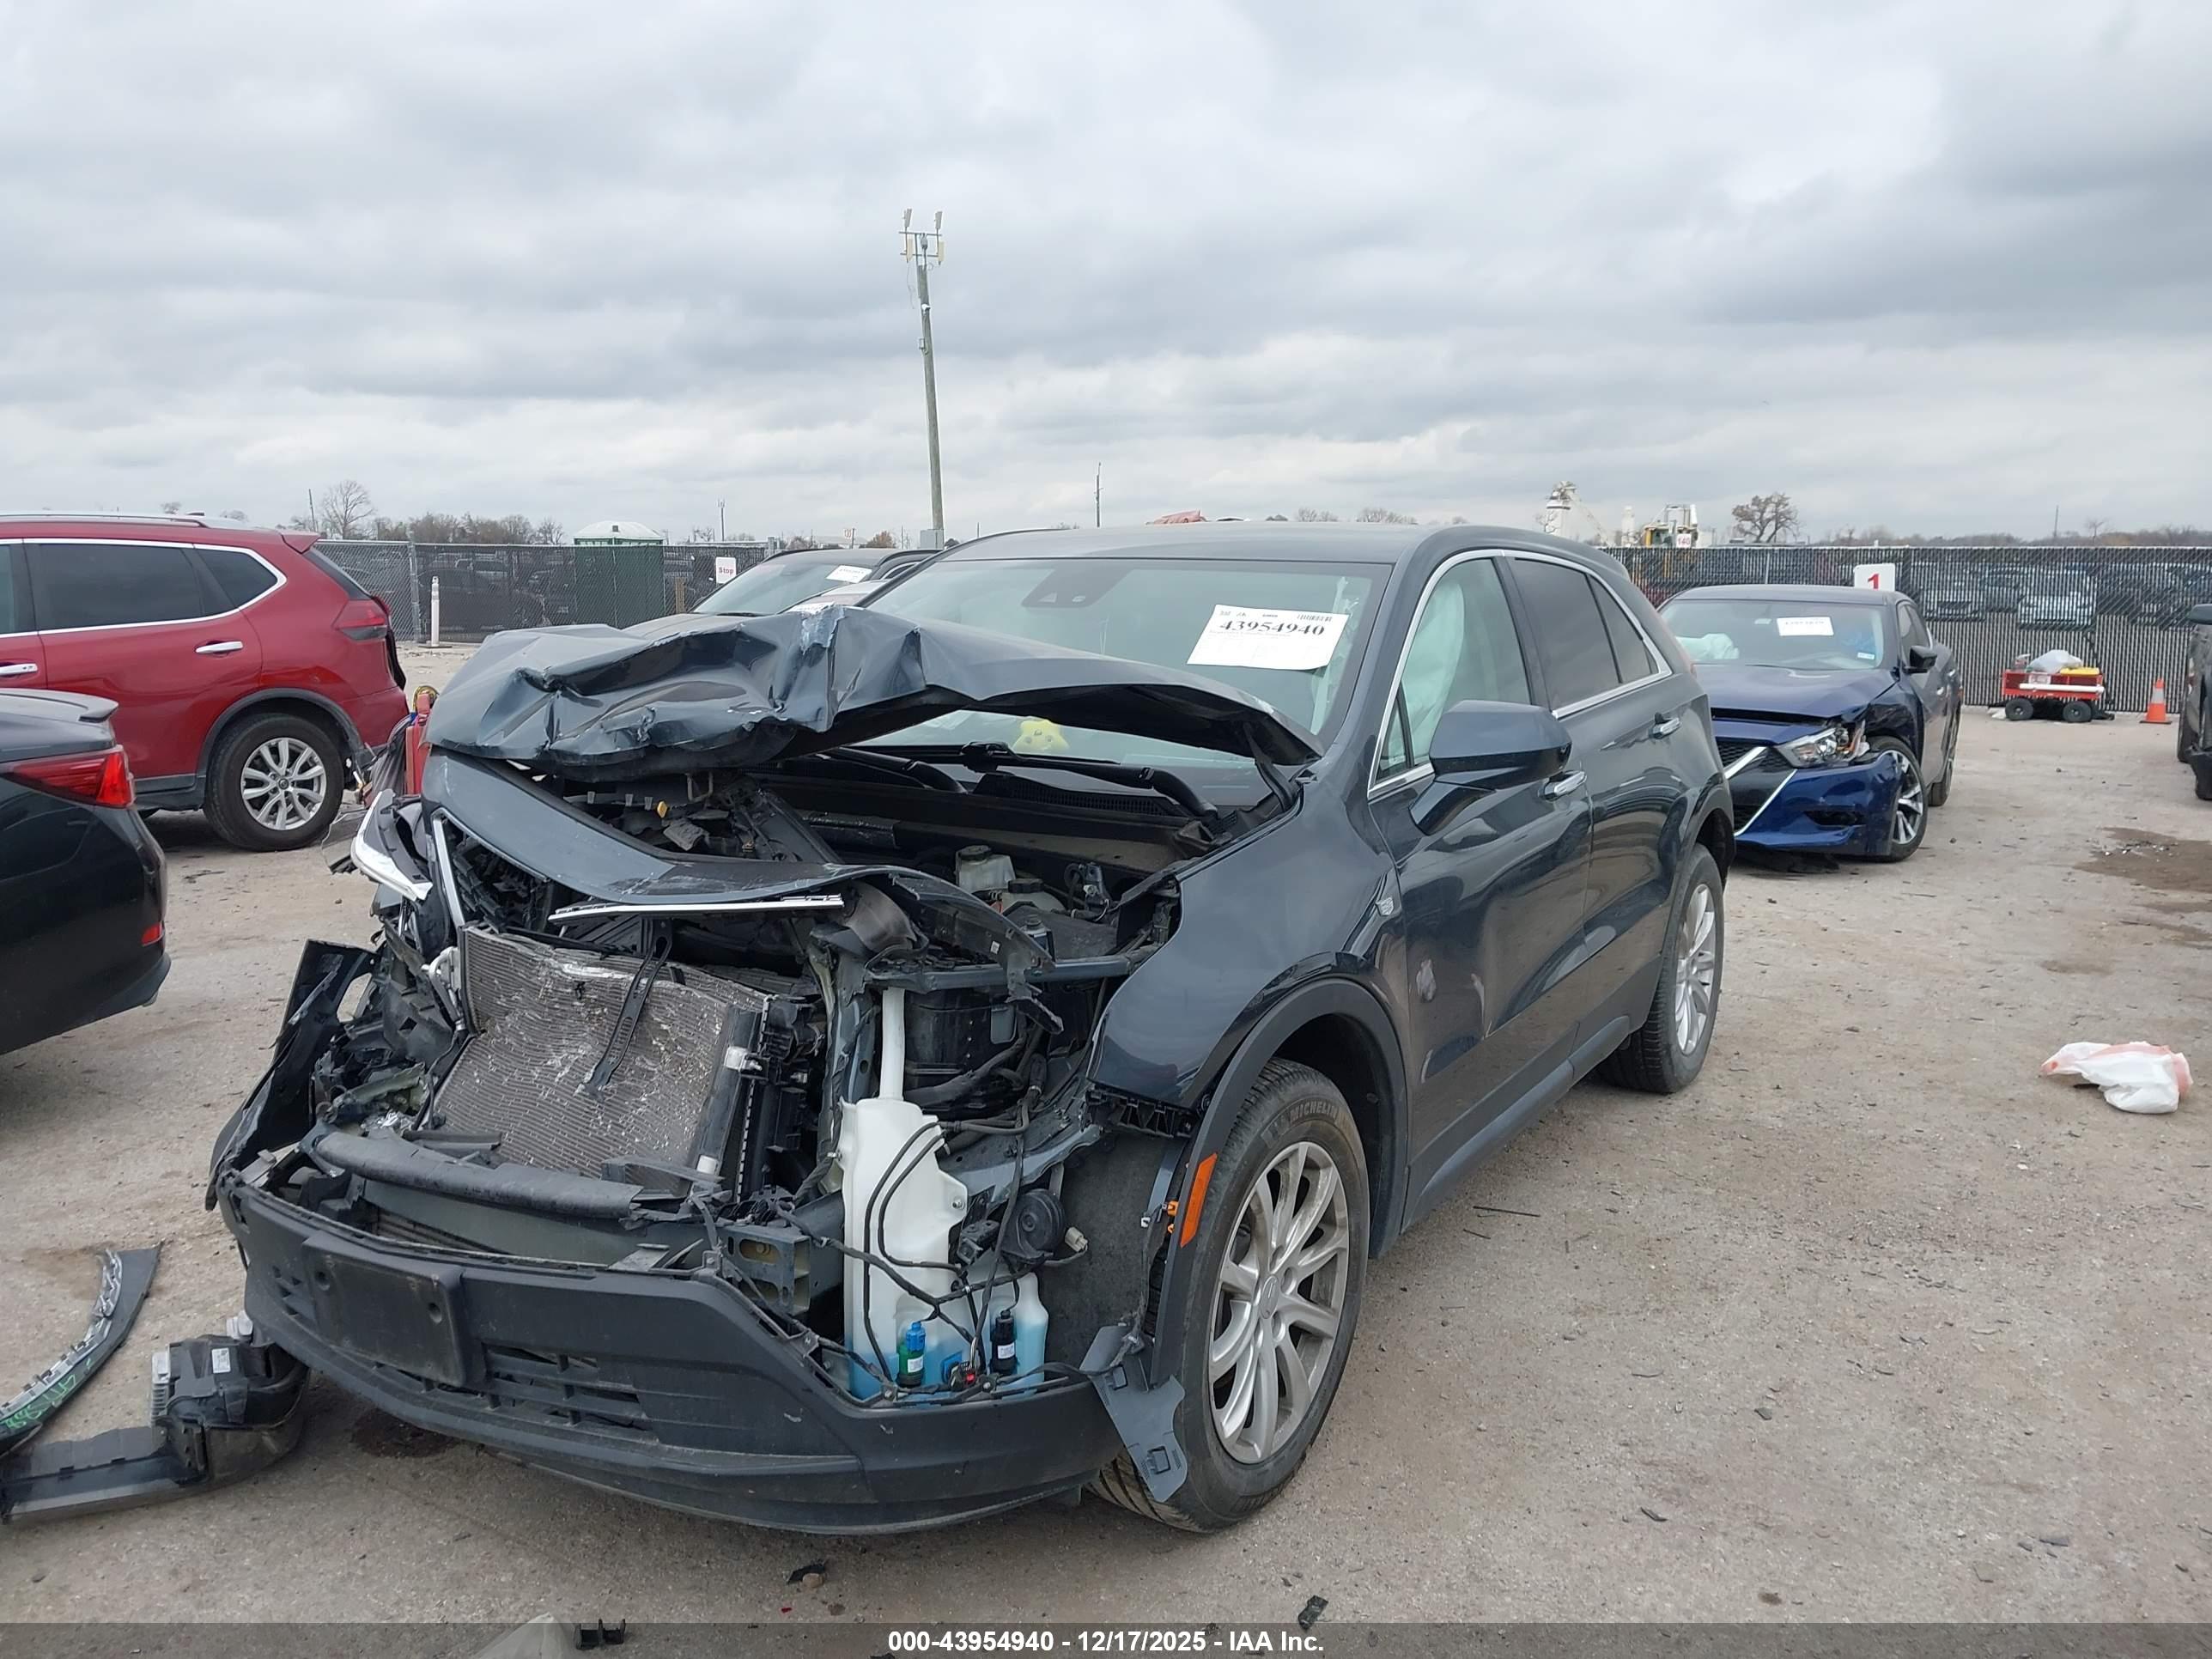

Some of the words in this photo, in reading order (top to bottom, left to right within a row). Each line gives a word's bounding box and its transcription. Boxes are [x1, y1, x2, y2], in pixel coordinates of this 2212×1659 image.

[718, 567, 734, 575] Stop
[1868, 573, 1880, 590] 1
[1219, 620, 1325, 635] 43954940
[1290, 1100, 1339, 1123] MICHELIN
